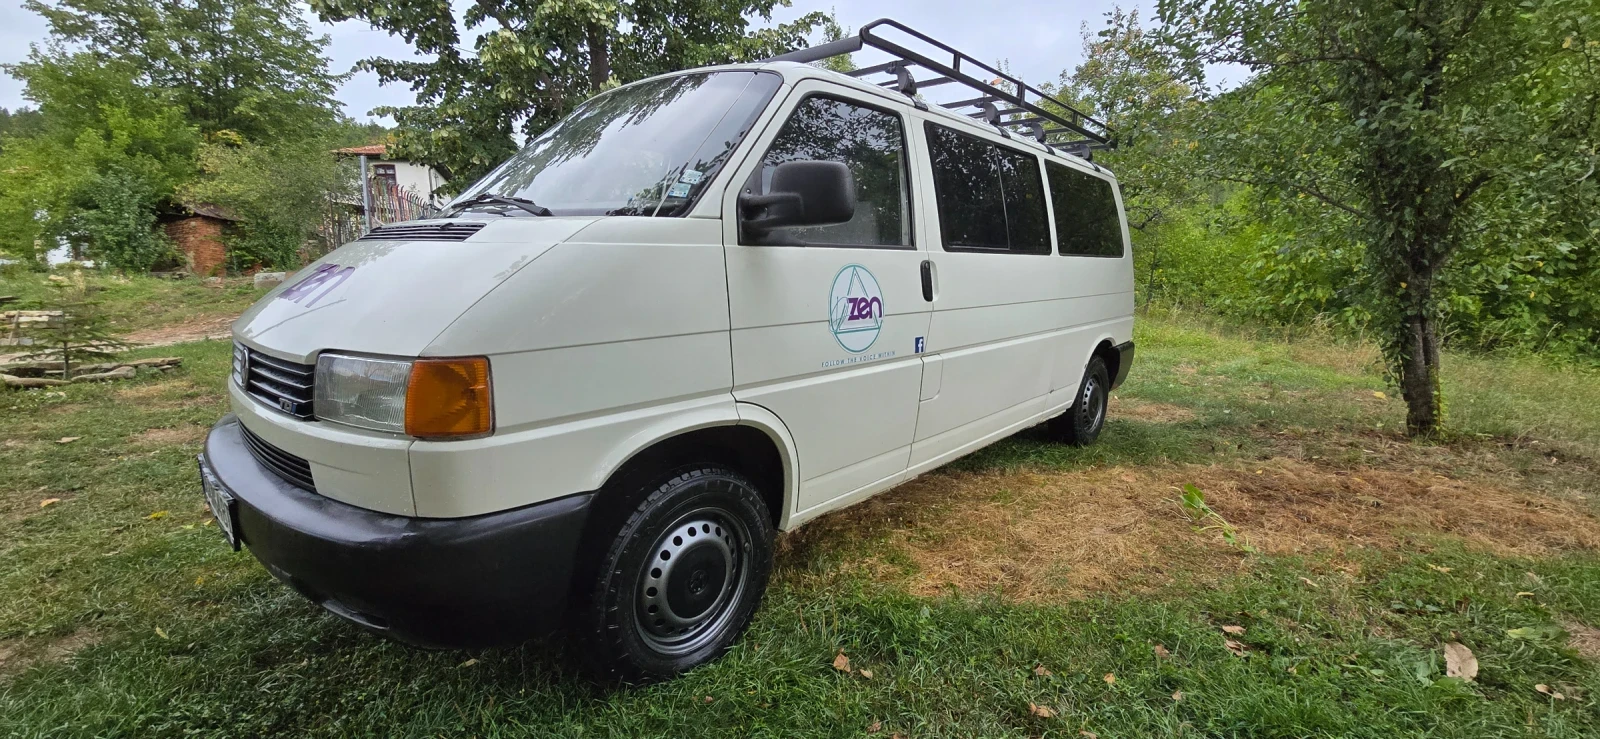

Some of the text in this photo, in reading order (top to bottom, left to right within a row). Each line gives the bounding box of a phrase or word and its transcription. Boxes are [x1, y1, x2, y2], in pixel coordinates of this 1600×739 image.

[916, 338, 923, 353] f
[821, 359, 845, 368] FOLLOW
[859, 354, 876, 362] VOICE
[877, 350, 896, 359] WITHIN
